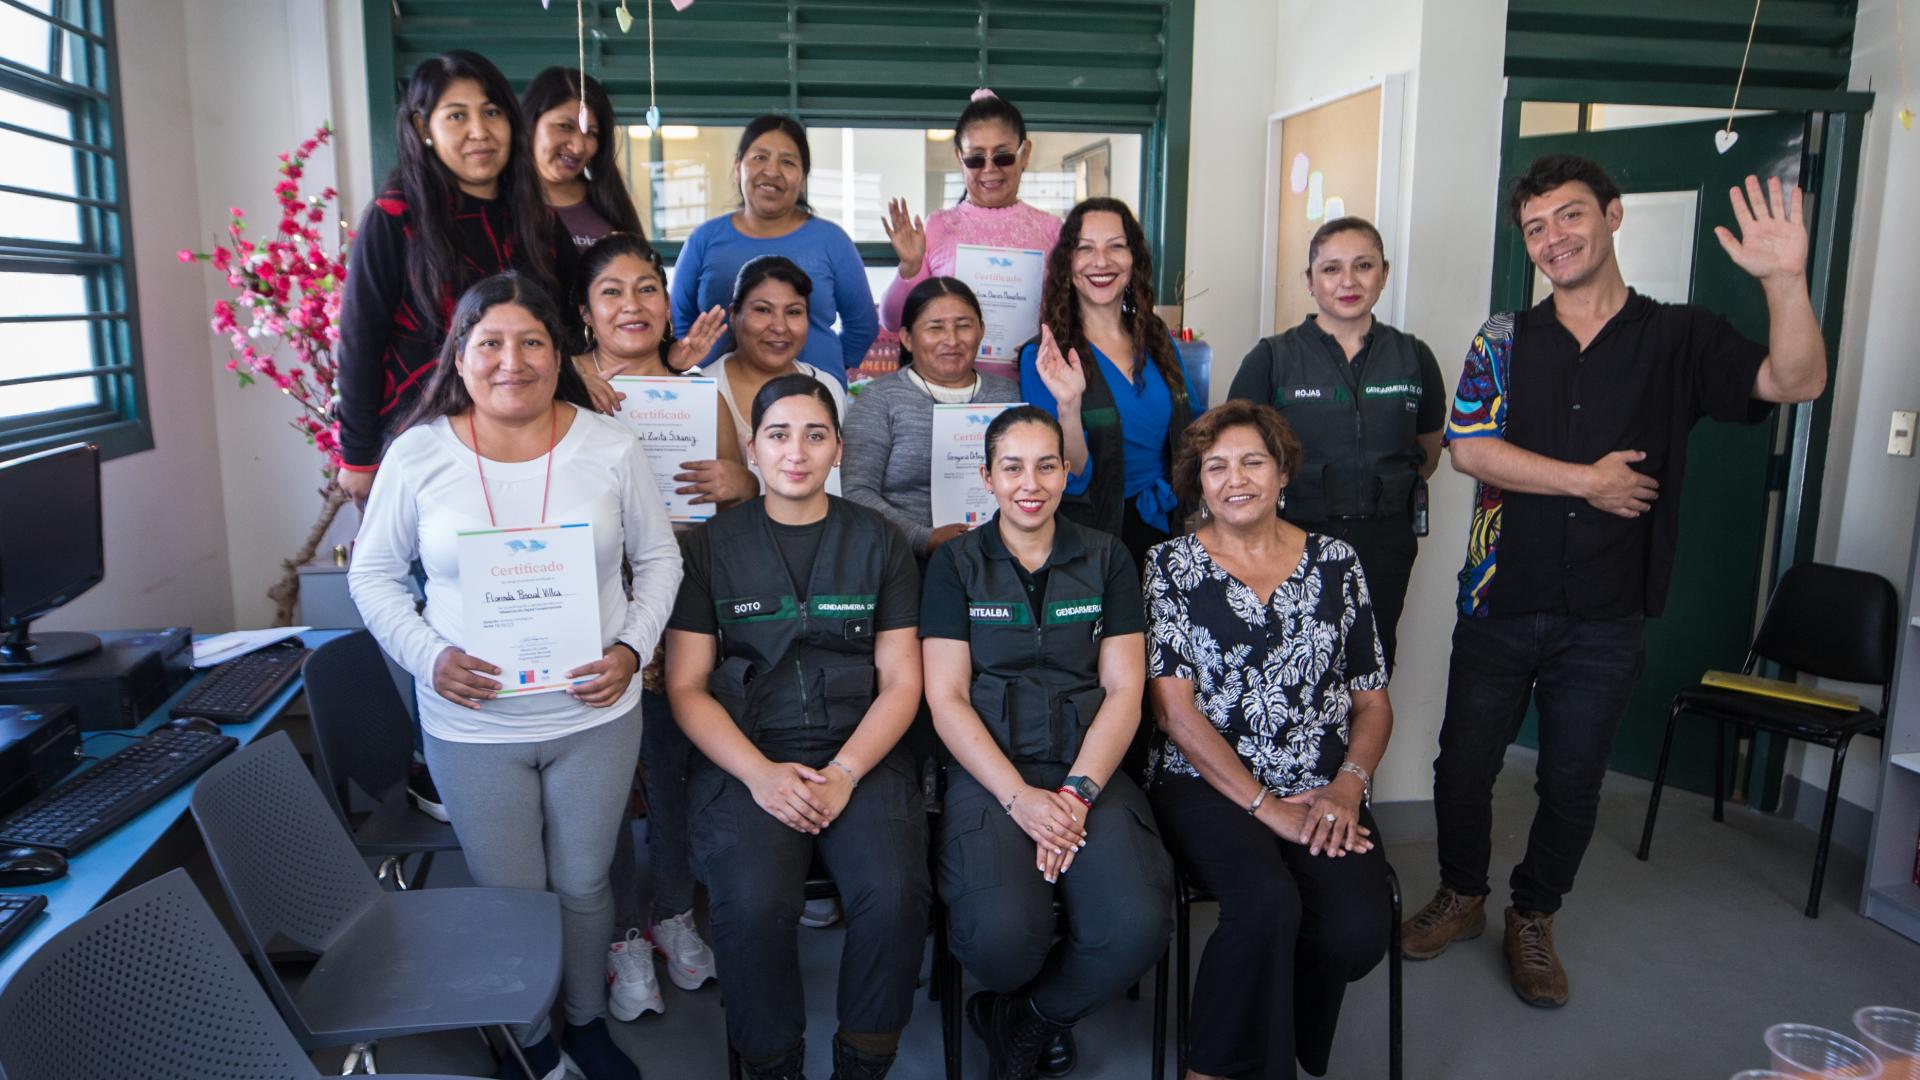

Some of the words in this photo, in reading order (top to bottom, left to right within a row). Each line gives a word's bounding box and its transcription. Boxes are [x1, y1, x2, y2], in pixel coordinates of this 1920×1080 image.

[1294, 389, 1321, 398] ROJAS
[630, 408, 690, 420] Certificado
[953, 432, 985, 442] Certifi
[490, 561, 565, 577] Certificado
[734, 601, 761, 614] SOTO
[817, 603, 866, 611] GENDARMERIA
